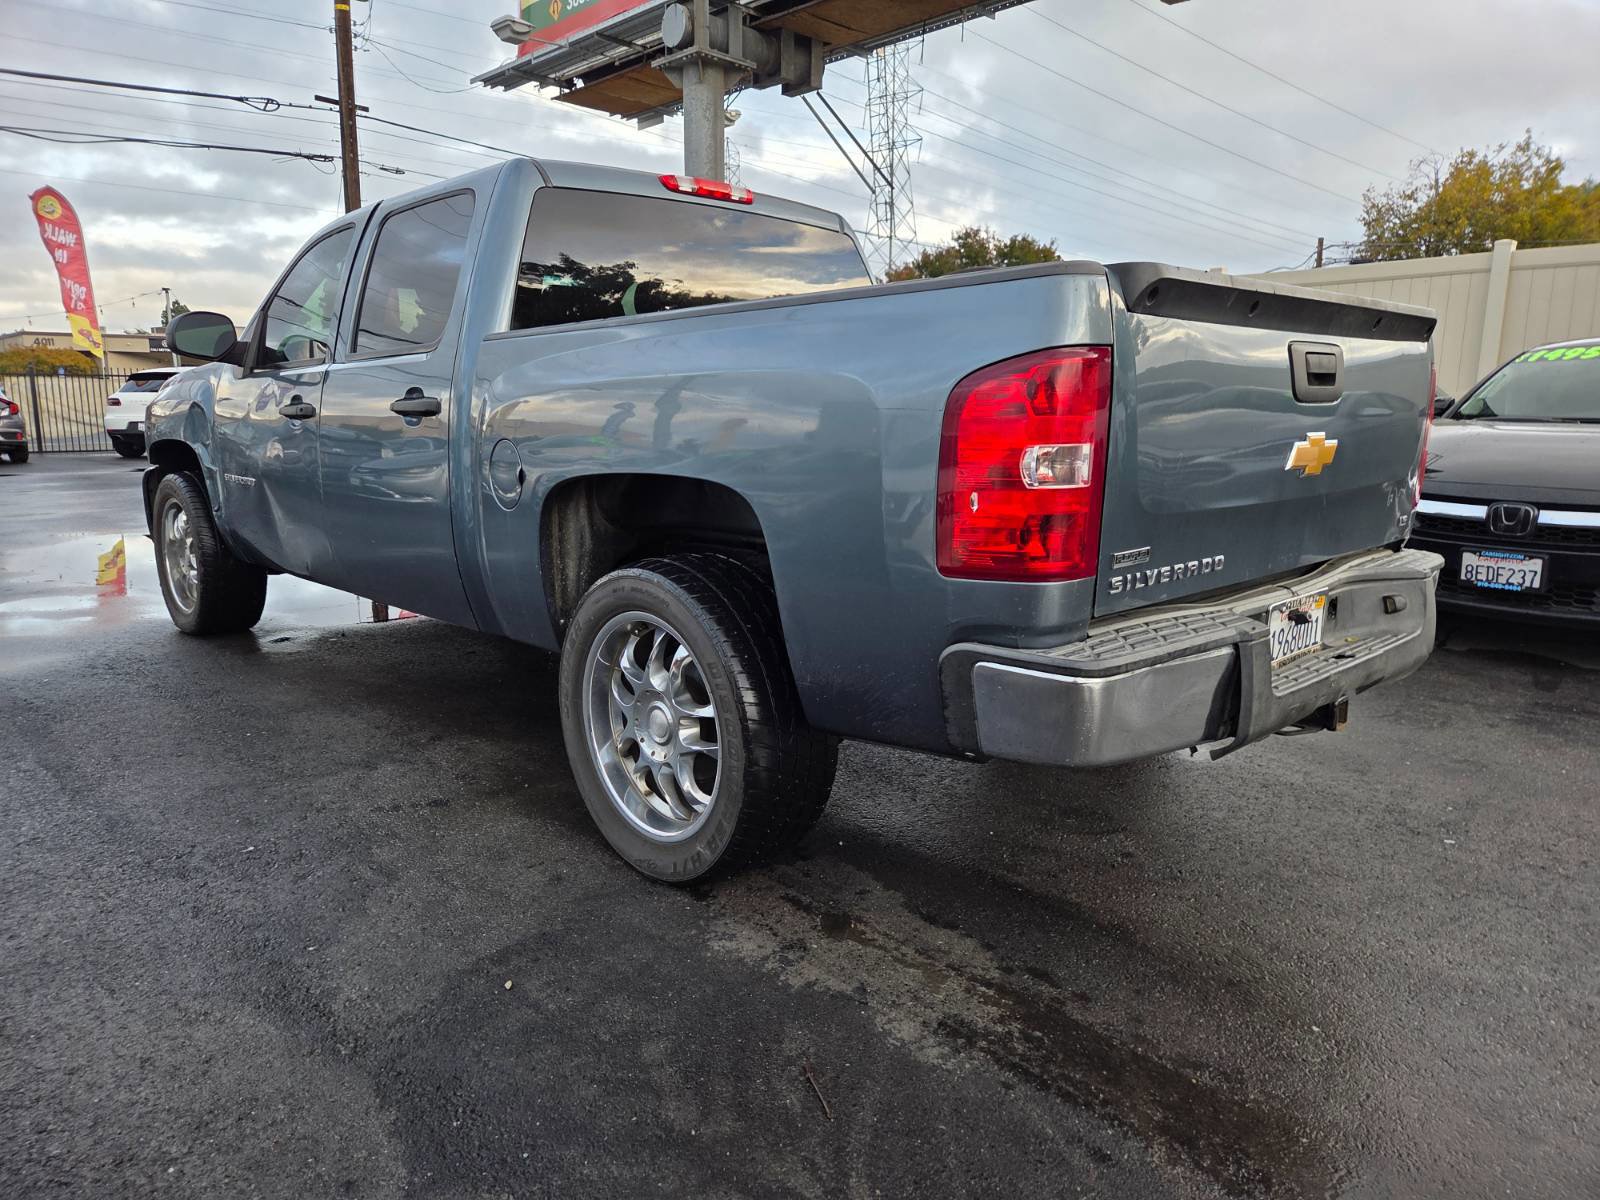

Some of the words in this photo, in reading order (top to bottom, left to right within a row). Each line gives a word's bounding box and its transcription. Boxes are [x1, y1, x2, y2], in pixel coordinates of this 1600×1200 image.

[33, 337, 55, 346] 4011
[1109, 554, 1225, 594] SILVERADO
[1464, 563, 1538, 588] 8EDF237
